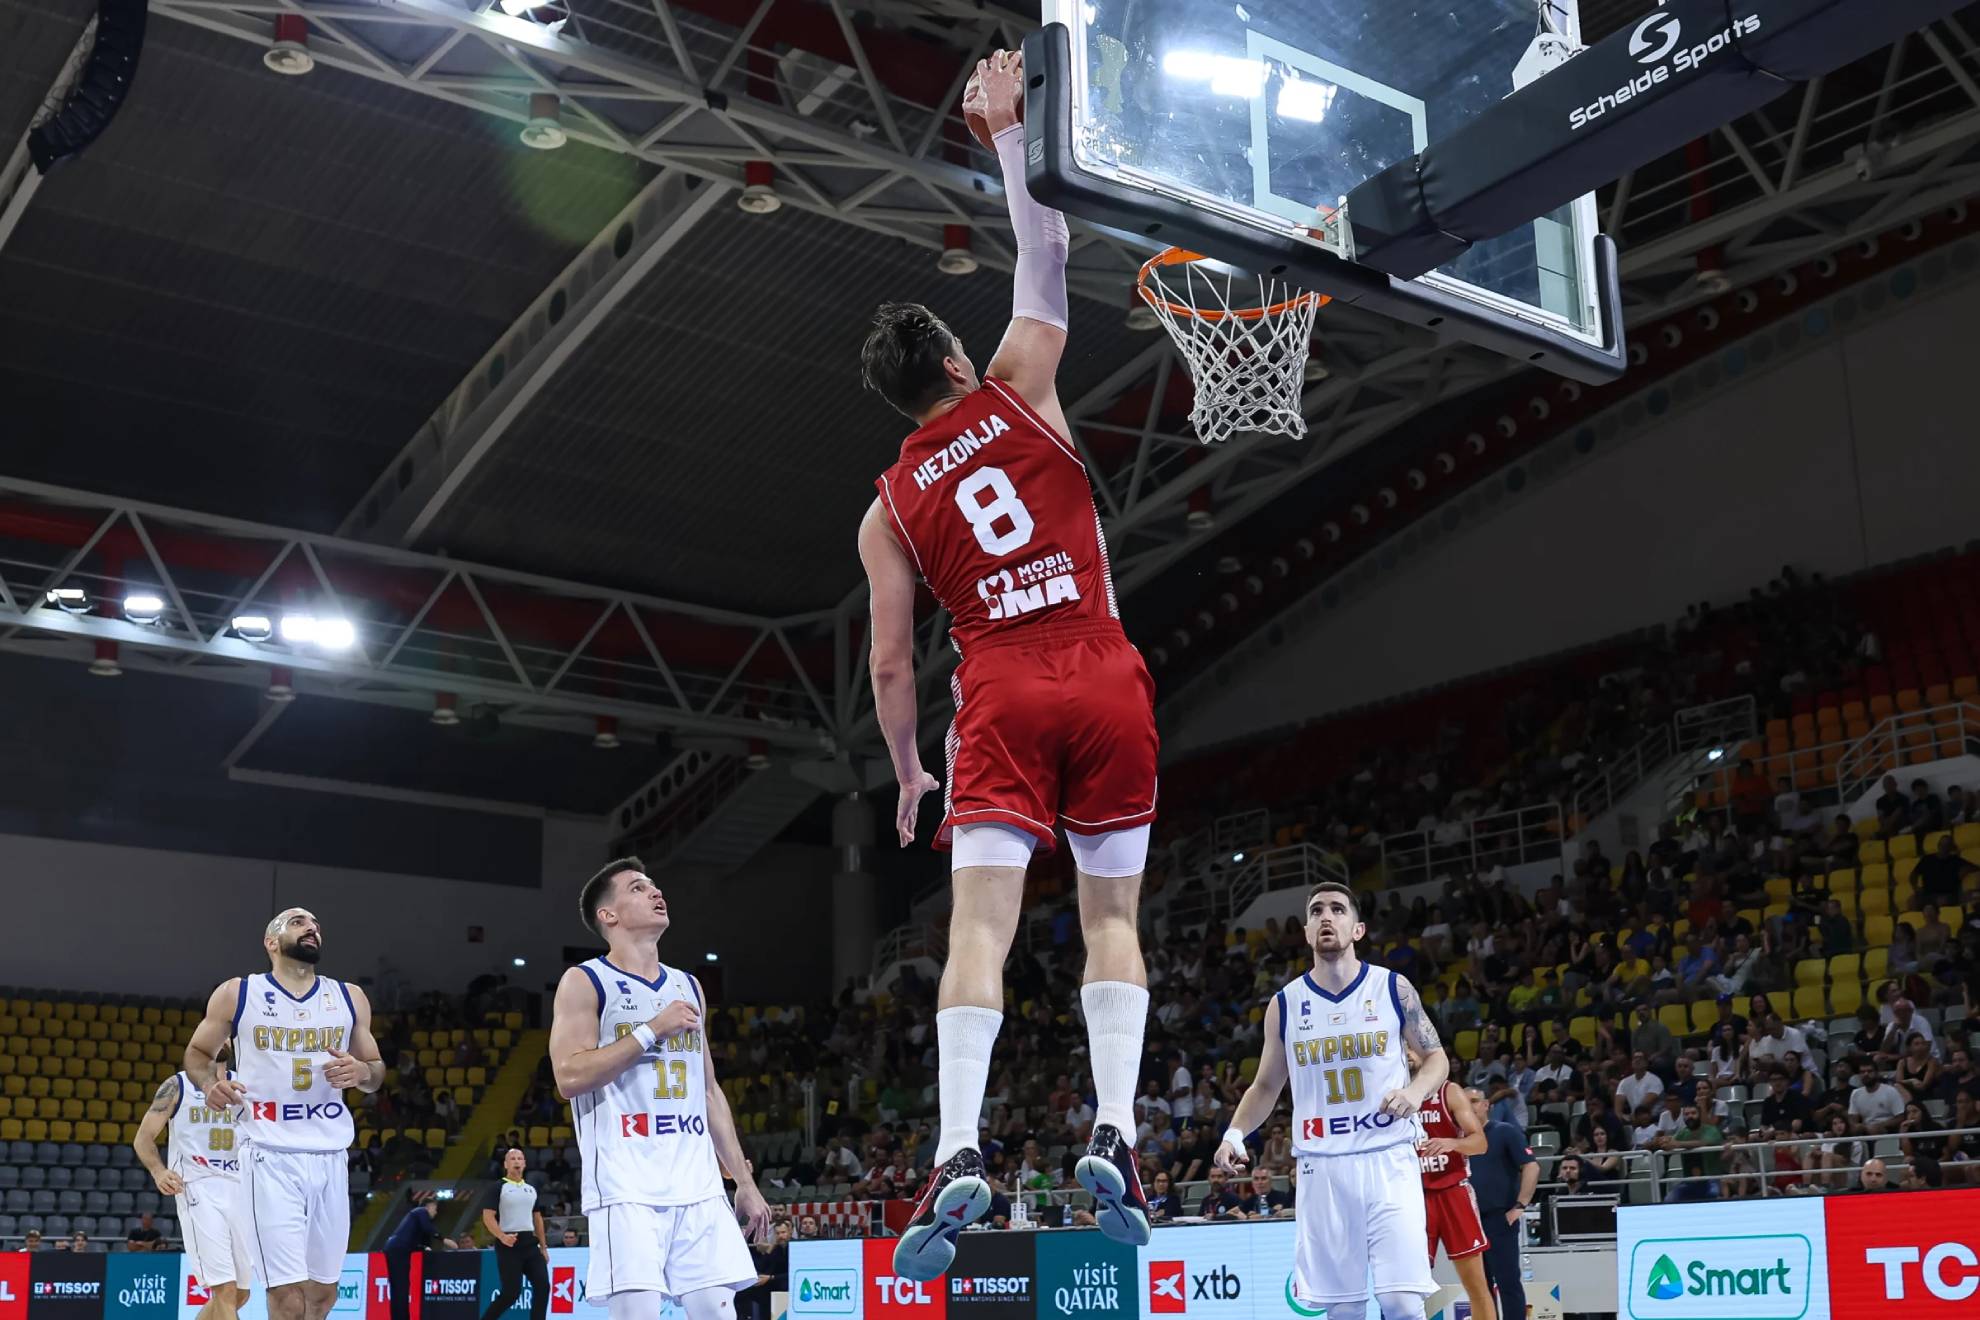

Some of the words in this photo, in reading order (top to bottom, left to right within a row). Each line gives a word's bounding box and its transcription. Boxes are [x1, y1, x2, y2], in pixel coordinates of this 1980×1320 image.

[1569, 65, 1669, 130] Schelde
[1673, 14, 1761, 72] Sports
[912, 414, 1011, 490] HEZONJA
[954, 465, 1035, 556] 8
[1017, 551, 1072, 578] MOBIL
[1021, 562, 1074, 585] LEASING
[1293, 1030, 1389, 1067] CYPRUS
[291, 1057, 312, 1092] 5
[652, 1059, 687, 1100] 13
[1323, 1066, 1365, 1105] 10
[282, 1101, 343, 1121] EKO
[1329, 1111, 1394, 1135] EKO
[655, 1114, 704, 1136] EKO
[1420, 1154, 1449, 1173] HEP
[133, 1274, 167, 1289] visit
[1073, 1262, 1119, 1286] visit
[1192, 1265, 1241, 1300] xtb
[1687, 1258, 1791, 1296] Smart
[1865, 1242, 1980, 1300] TC
[53, 1282, 100, 1294] TISSOT
[118, 1289, 166, 1307] QATAR
[439, 1279, 477, 1294] TISSOT
[813, 1281, 850, 1300] Smart
[875, 1276, 932, 1305] TCL
[973, 1277, 1029, 1294] TISSOT
[1055, 1287, 1119, 1315] QATAR
